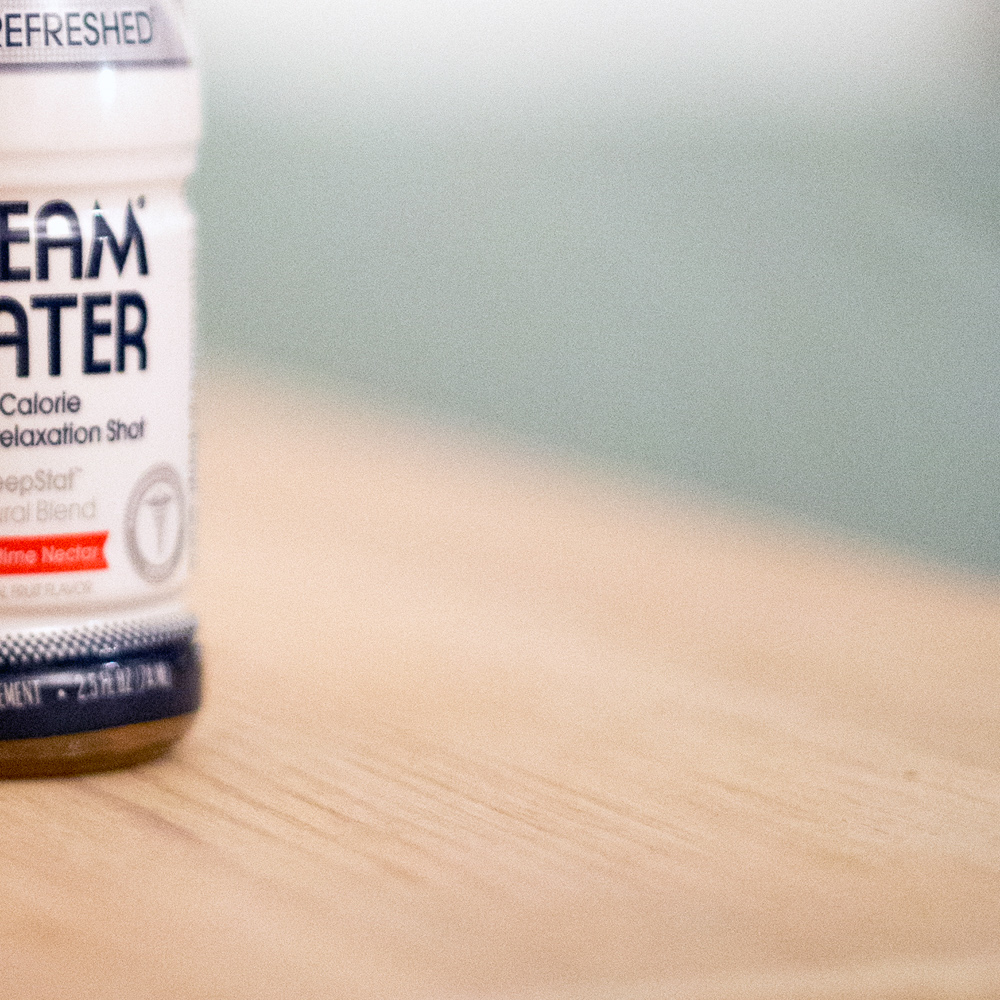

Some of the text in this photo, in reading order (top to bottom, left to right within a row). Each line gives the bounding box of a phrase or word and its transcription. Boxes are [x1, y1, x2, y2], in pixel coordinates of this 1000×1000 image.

[106, 416, 147, 443] Shot
[36, 498, 97, 522] Blend
[41, 544, 99, 564] Nectar
